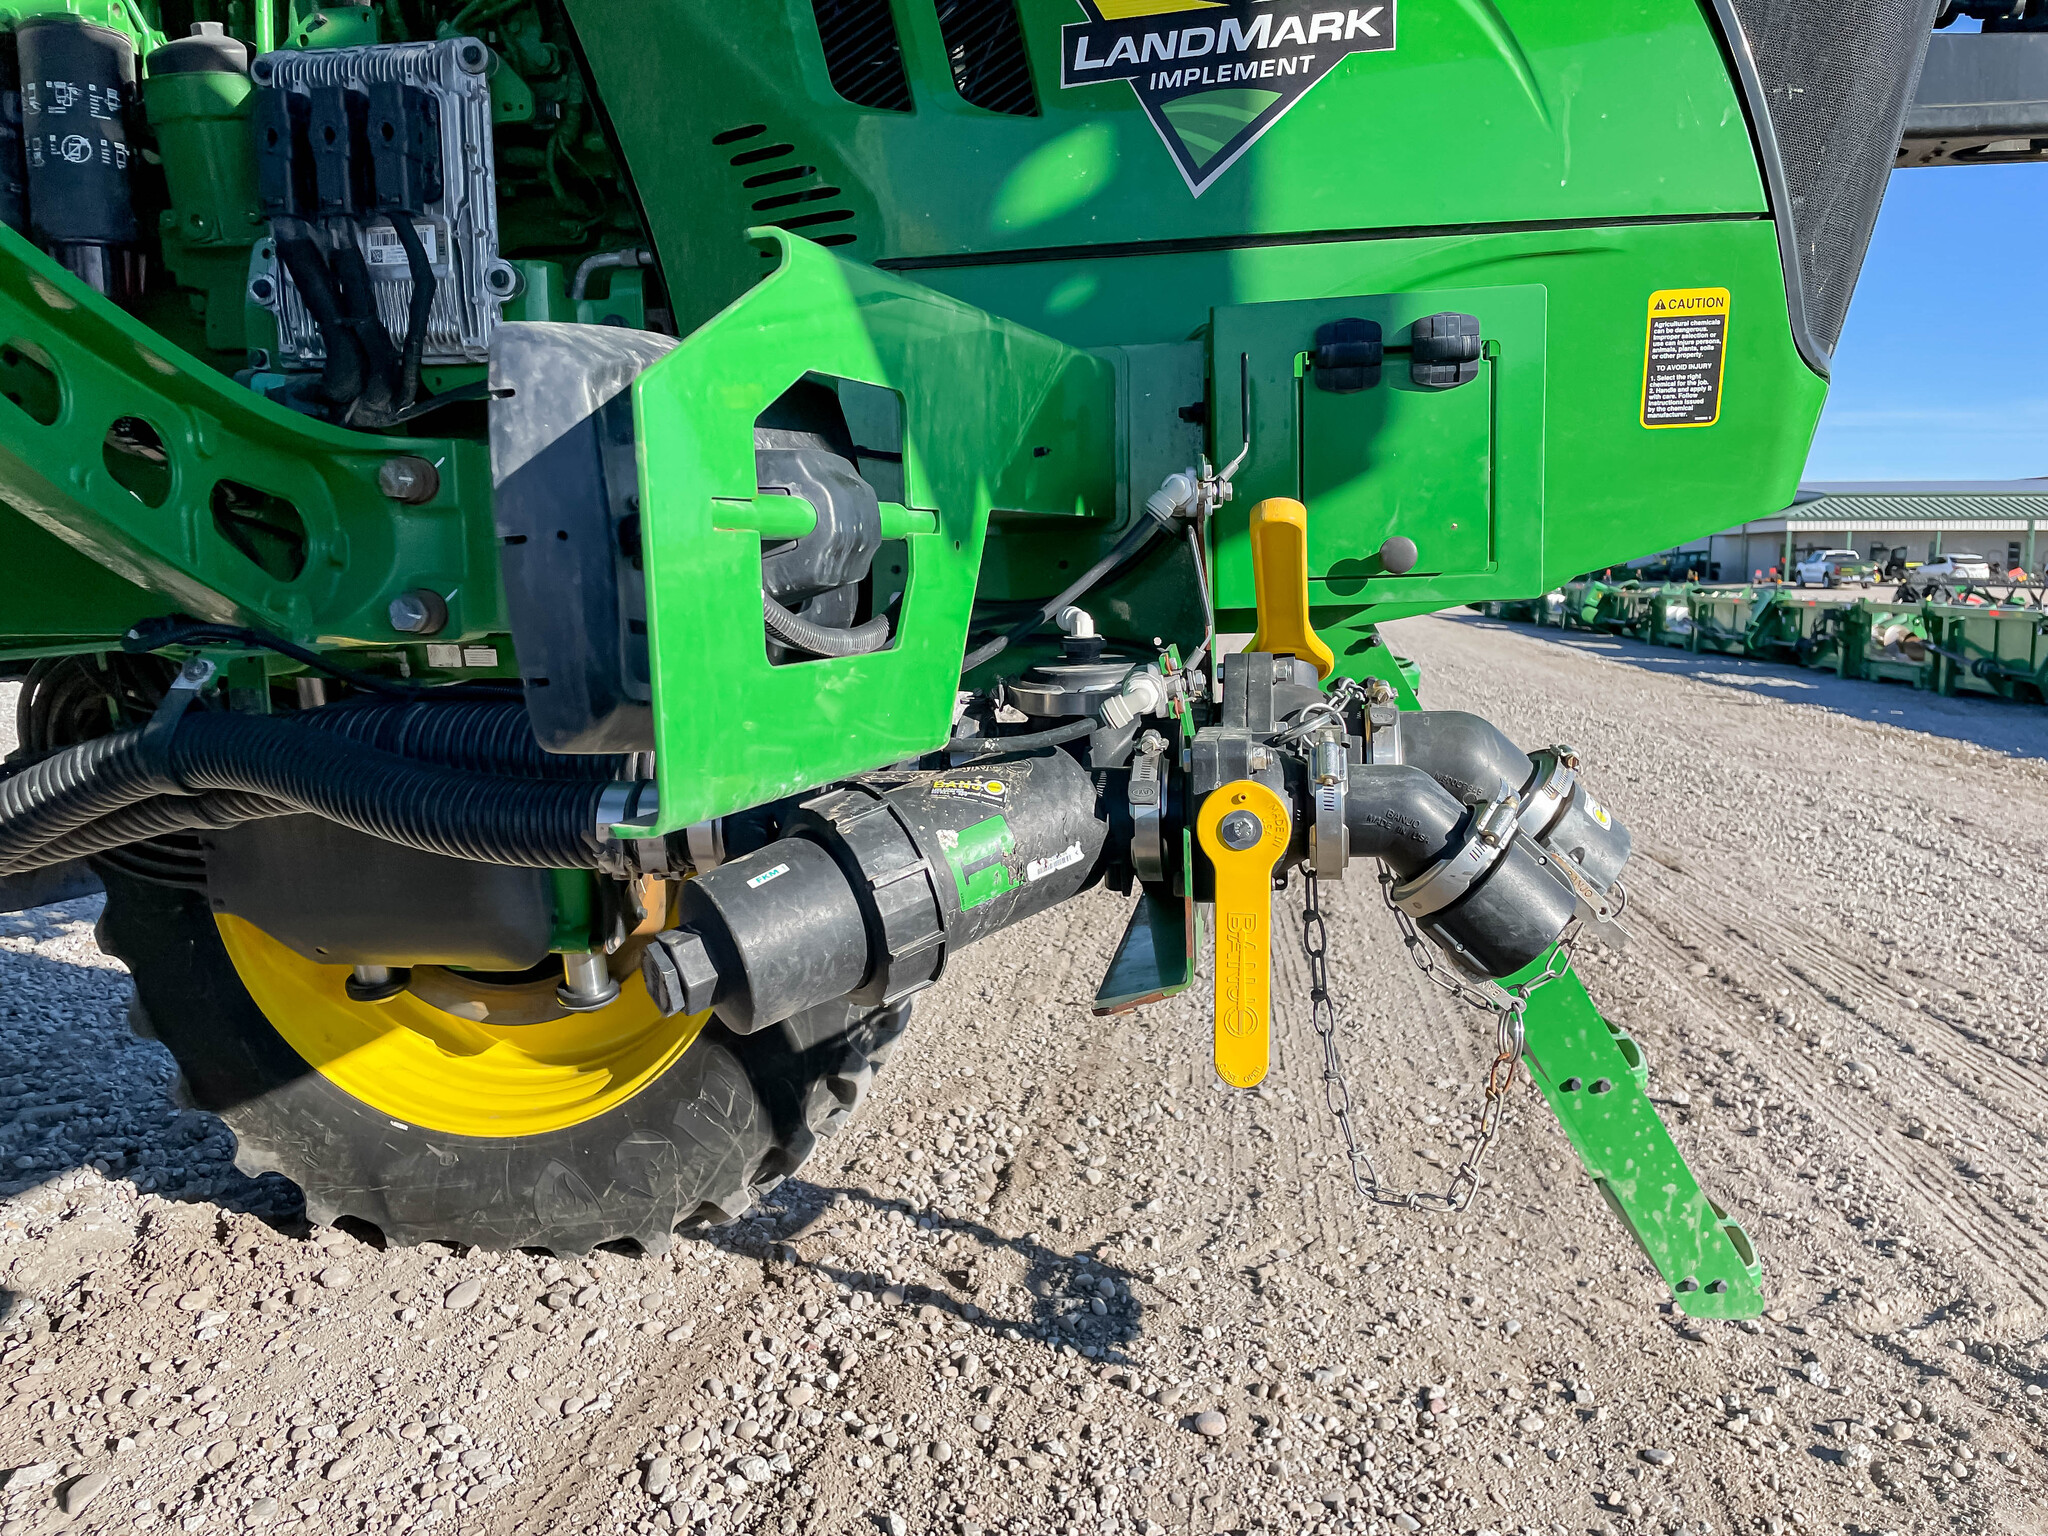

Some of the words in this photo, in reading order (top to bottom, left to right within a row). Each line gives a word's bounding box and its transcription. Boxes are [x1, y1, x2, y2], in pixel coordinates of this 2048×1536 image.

[1150, 54, 1316, 91] IMPLEMENT
[1668, 297, 1724, 310] CAUTION
[1654, 320, 1690, 328] Agricultural
[1676, 352, 1703, 360] property.
[1386, 808, 1421, 829] BANJO
[1366, 814, 1393, 830] MADE
[1396, 826, 1406, 836] IN
[1411, 831, 1431, 845] USA
[755, 869, 779, 883] FKM
[1223, 912, 1259, 1038] BANJO
